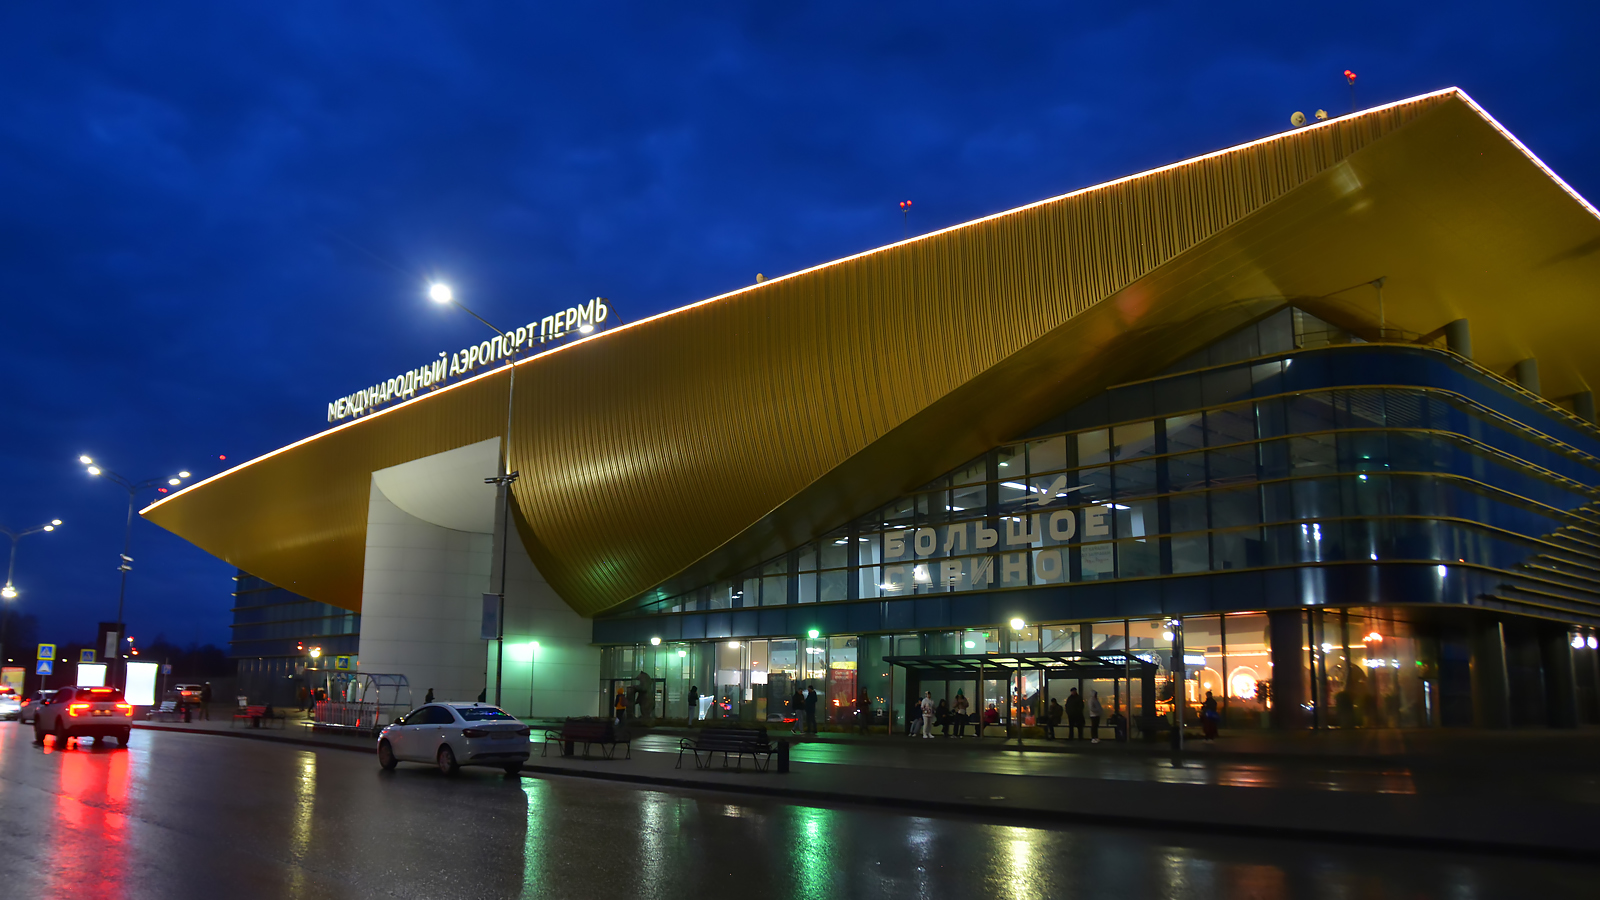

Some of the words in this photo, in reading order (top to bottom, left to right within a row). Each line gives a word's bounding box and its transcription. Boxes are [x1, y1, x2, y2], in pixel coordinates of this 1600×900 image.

[328, 351, 448, 422] МЕЖДУНАРОДНЫЙ
[449, 322, 538, 377] АЭРОПОРТ
[541, 297, 608, 343] ПЕРМЬ
[884, 506, 1109, 558] БОЛЬШОЕ
[884, 550, 1062, 592] САВИНО
